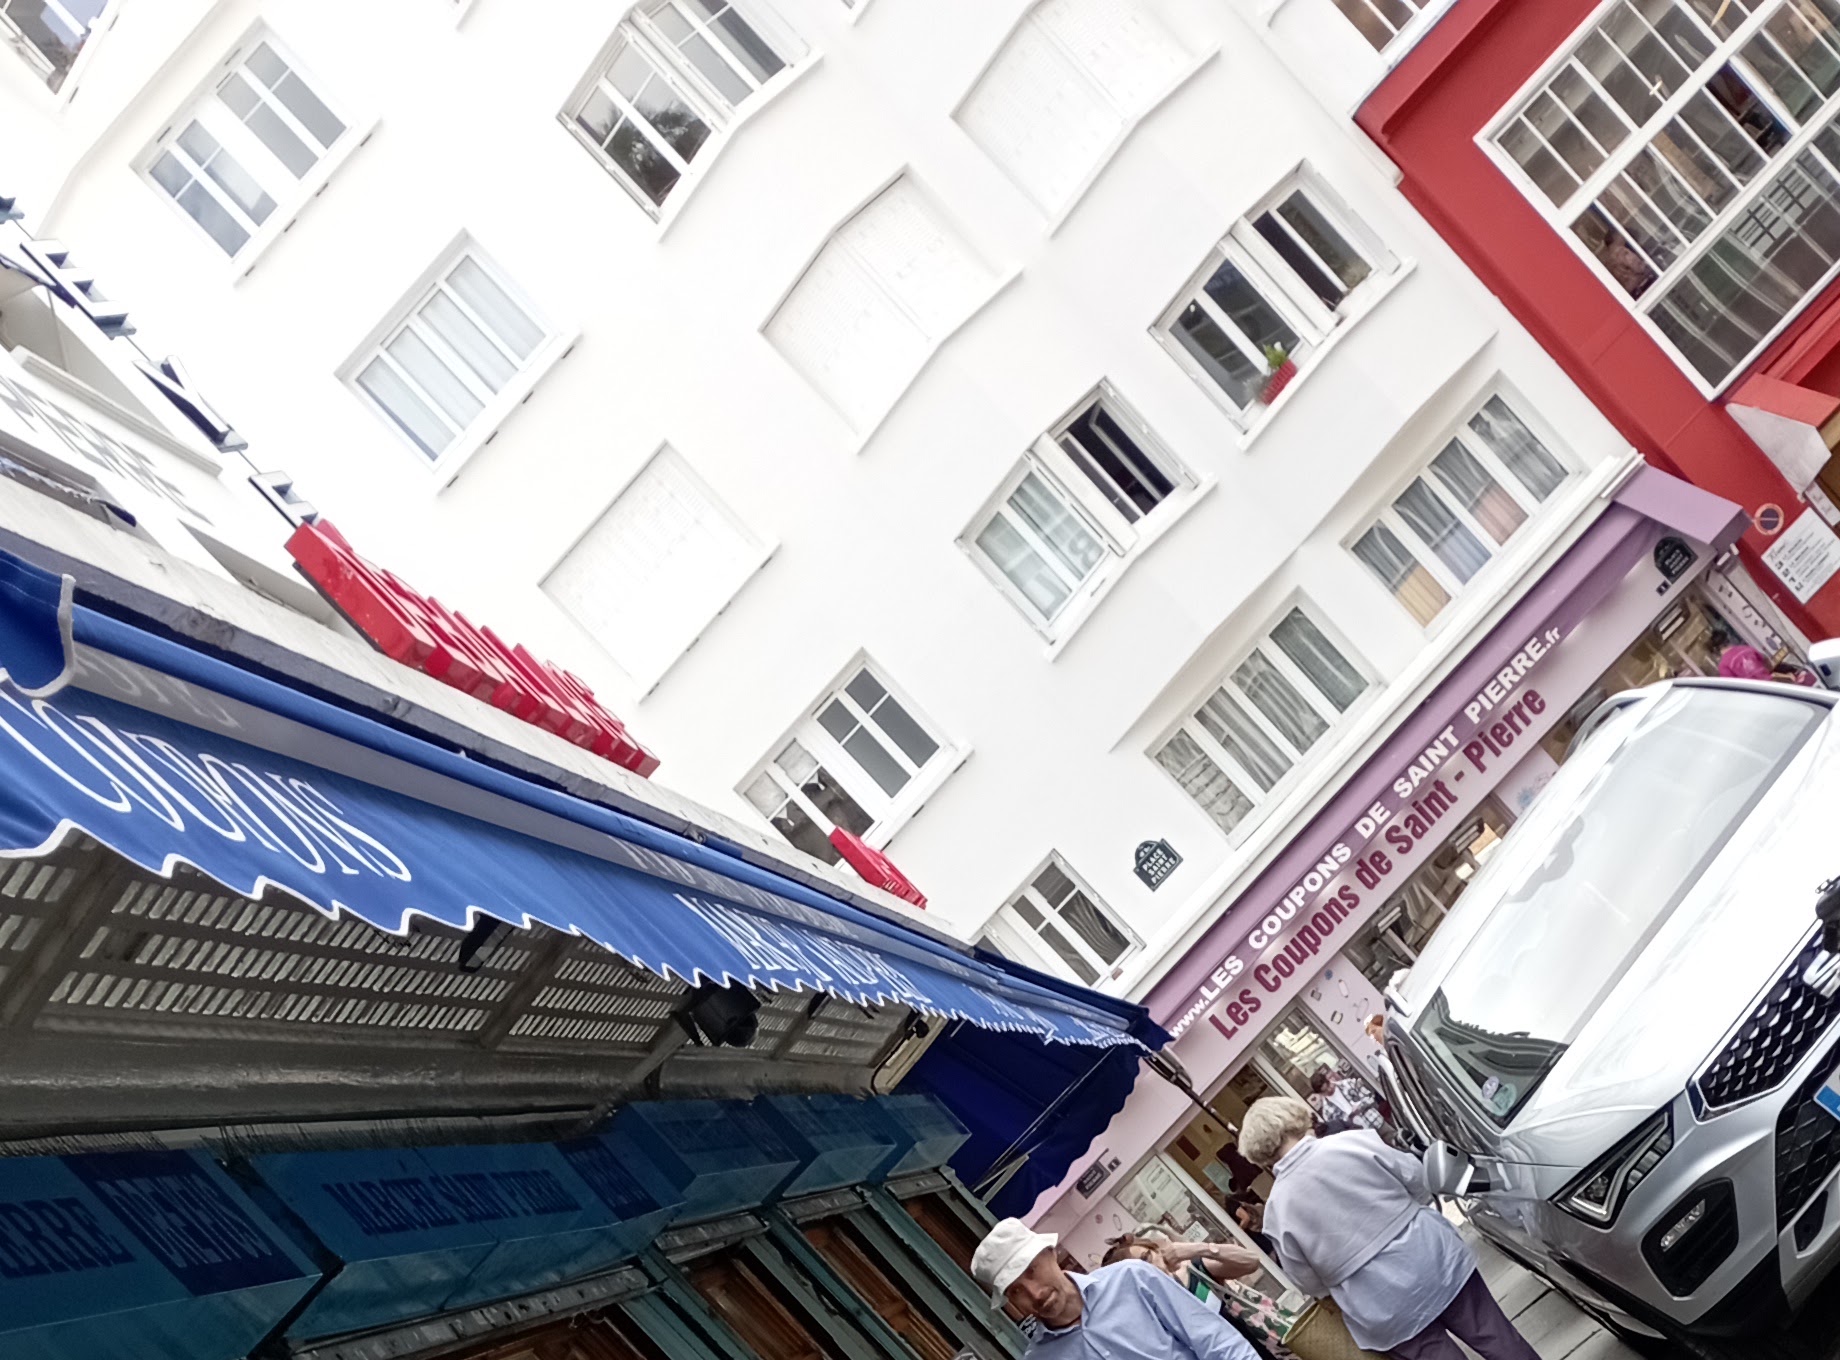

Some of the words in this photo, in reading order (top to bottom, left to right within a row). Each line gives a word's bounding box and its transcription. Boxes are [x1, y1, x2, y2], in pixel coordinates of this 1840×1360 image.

[1142, 848, 1163, 872] PLACE
[1248, 842, 1351, 949] COUPONS
[1354, 801, 1391, 839] DE
[1393, 725, 1459, 799] SAINT
[1148, 853, 1168, 876] SAINT
[1150, 857, 1176, 884] PIERRE
[1208, 988, 1262, 1040] Les
[1253, 884, 1360, 993] Coupons
[1355, 849, 1393, 890] de
[1384, 779, 1458, 855] Saint
[1462, 689, 1546, 774] Pierre
[95, 1171, 273, 1269] DREYFUS
[428, 1173, 518, 1224] SAINT
